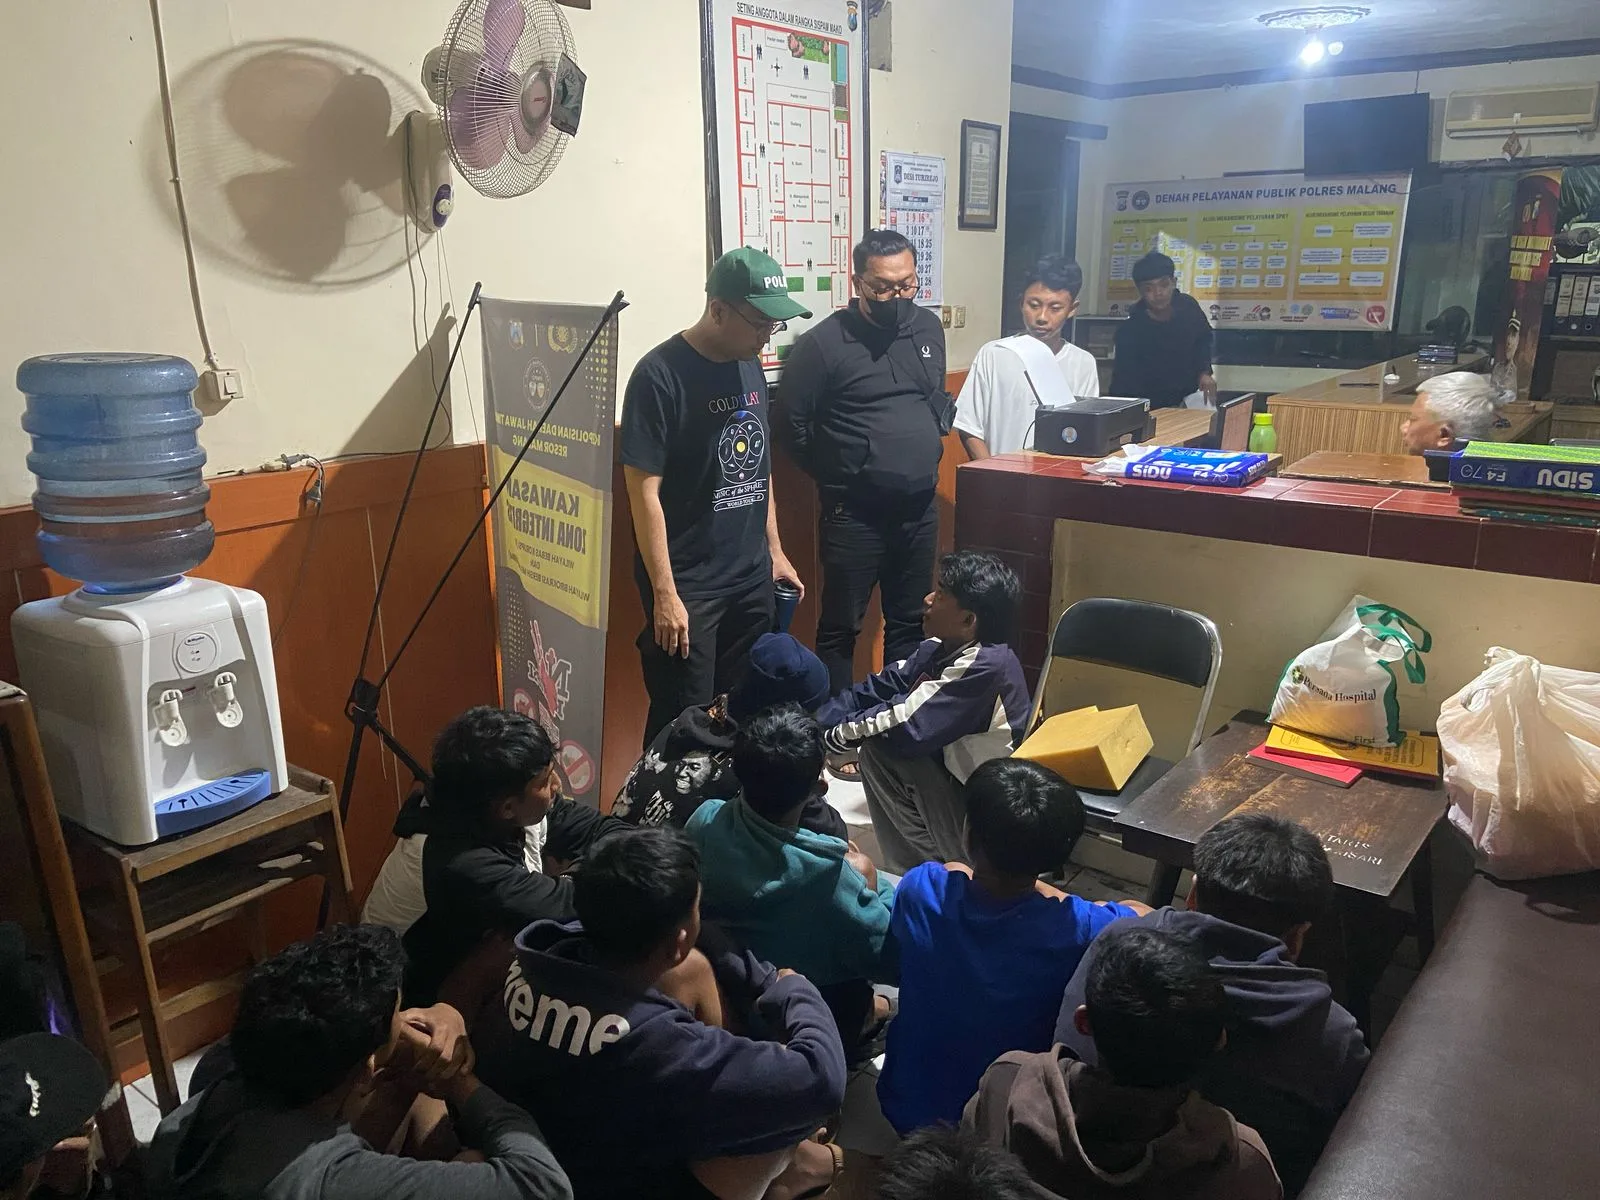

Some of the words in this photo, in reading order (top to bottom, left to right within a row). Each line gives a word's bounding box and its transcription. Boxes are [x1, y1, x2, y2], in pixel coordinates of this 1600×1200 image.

[736, 1, 755, 15] SETING
[755, 6, 778, 19] ANGGOTA
[779, 11, 795, 22] DALAM
[795, 15, 814, 27] RANGKA
[1155, 193, 1189, 204] DENAH
[1192, 189, 1253, 202] PELAYANAN
[1256, 187, 1296, 199] PUBLIK
[1299, 185, 1344, 197] POLRES
[1346, 183, 1397, 196] MALANG
[918, 213, 925, 223] 16
[911, 226, 917, 236] 10
[918, 226, 925, 236] 17
[918, 239, 925, 249] 18
[925, 239, 933, 249] 25
[917, 251, 925, 261] 19
[925, 251, 932, 261] 26
[925, 264, 932, 274] 27
[925, 277, 932, 286] 28
[925, 289, 932, 299] 29
[708, 391, 760, 414] COLDPLAY
[1131, 464, 1172, 480] SiDU
[1193, 470, 1208, 479] F4
[1211, 472, 1229, 484] 70
[1460, 464, 1483, 479] 70
[1486, 470, 1506, 482] F4
[1536, 468, 1594, 490] SiDU
[1335, 688, 1377, 704] Hospital
[1354, 735, 1376, 744] First
